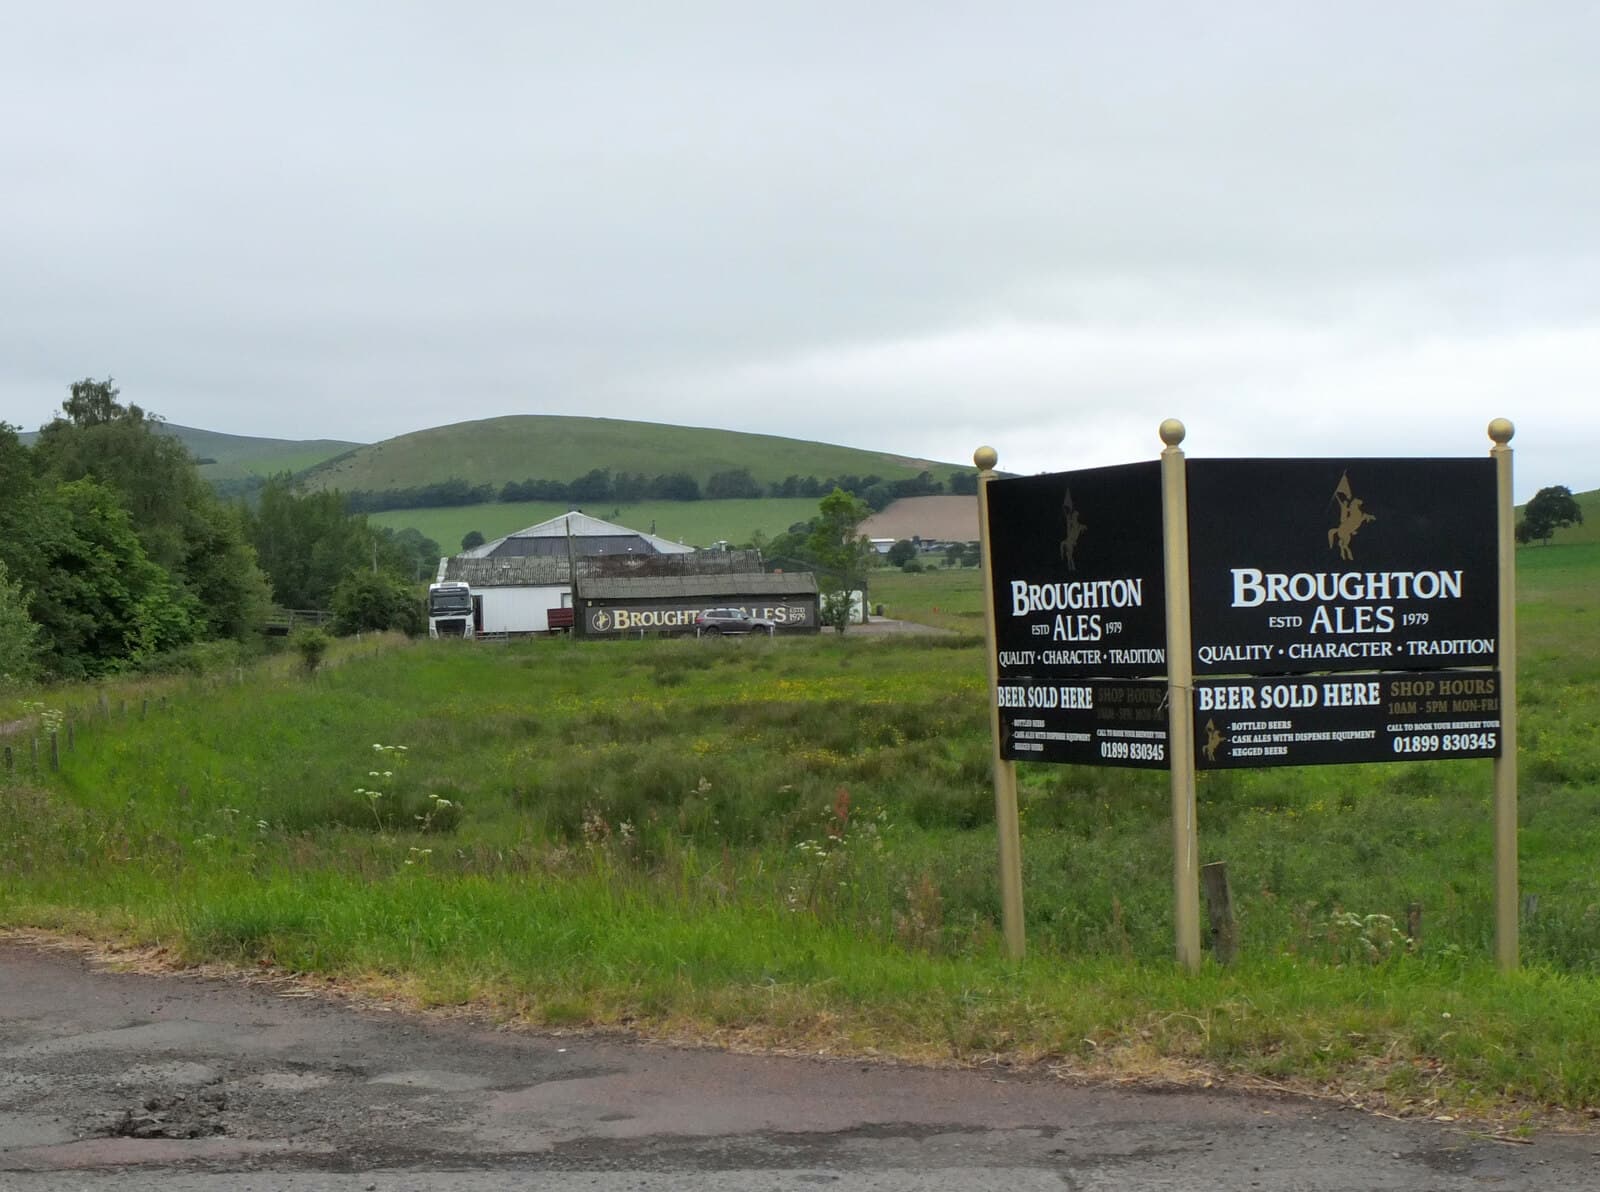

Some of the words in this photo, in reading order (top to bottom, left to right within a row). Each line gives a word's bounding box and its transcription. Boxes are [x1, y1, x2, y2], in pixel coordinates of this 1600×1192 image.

[1010, 578, 1142, 616] BROUGHTON
[1230, 568, 1464, 608] BROUGHTON
[613, 609, 699, 629] BROUGHT
[1031, 624, 1050, 635] ESTD
[1053, 614, 1102, 641] ALES
[1105, 621, 1122, 634] 1979
[1269, 616, 1303, 628] ESTD
[1309, 605, 1395, 634] ALES
[1402, 613, 1429, 626] 1979
[998, 651, 1035, 667] QUALITY
[1042, 649, 1102, 665] CHARACTER
[1109, 648, 1165, 664] TRADITION
[1198, 645, 1274, 664] QUALITY
[1288, 641, 1393, 659] CHARACTER
[1406, 639, 1495, 656] TRADITION
[997, 686, 1026, 707] BEER
[1027, 687, 1058, 708] SOLD
[1060, 687, 1093, 709] HERE
[1199, 686, 1256, 710] BEER
[1260, 684, 1318, 708] SOLD
[1323, 682, 1381, 707] HERE
[1390, 681, 1435, 696] SHOP
[1439, 679, 1495, 695] HOURS
[1388, 701, 1417, 715] 10AM
[1426, 700, 1448, 713] 5PM
[1231, 722, 1267, 731] BOTTLED
[1268, 721, 1292, 730] BEERS
[1386, 724, 1403, 732] CALL
[1404, 723, 1414, 731] TO
[1101, 741, 1128, 758] 01899
[1129, 743, 1164, 760] 830345
[1393, 735, 1439, 753] 01899
[1442, 733, 1496, 751] 830345
